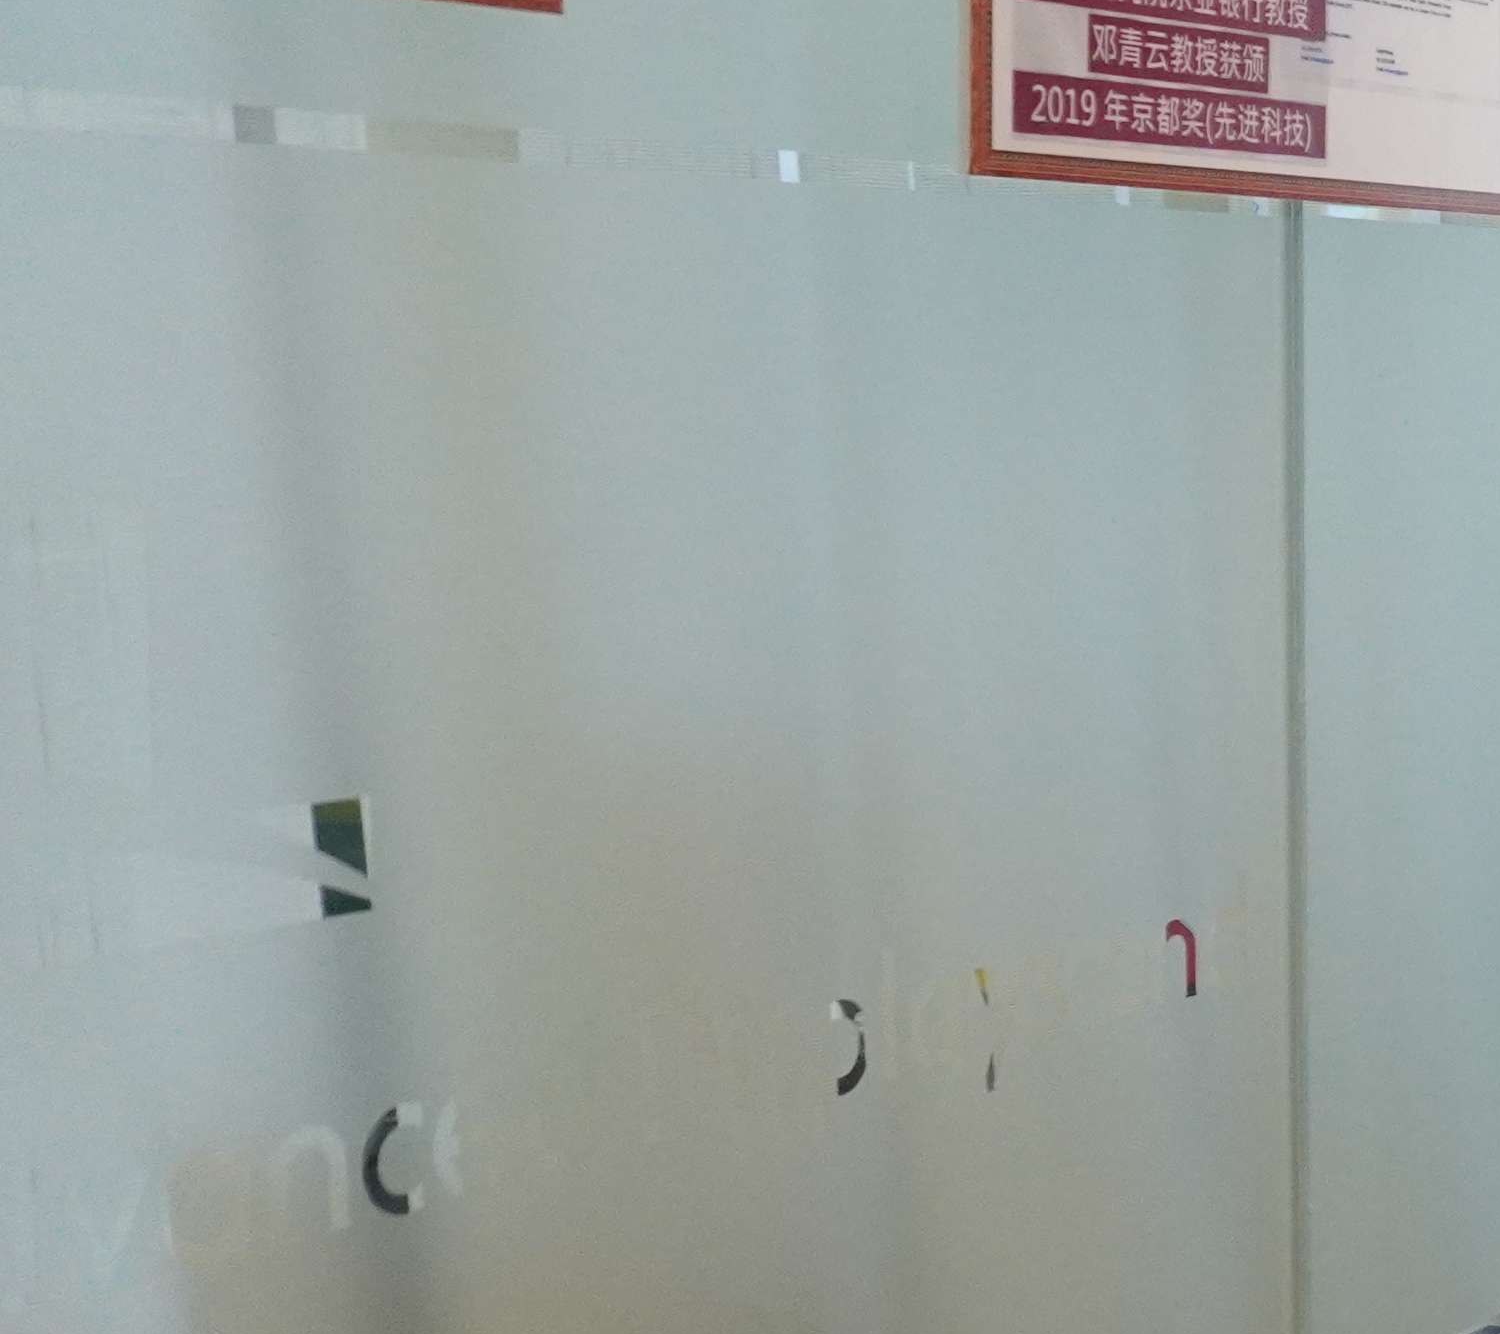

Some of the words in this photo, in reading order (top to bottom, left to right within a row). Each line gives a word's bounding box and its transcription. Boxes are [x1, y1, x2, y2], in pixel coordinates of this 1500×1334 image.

[1090, 23, 1268, 84] 邓青云教授获颁
[1030, 83, 1097, 128] 2019
[1103, 88, 1313, 153] 年京都奖(先进科技)
